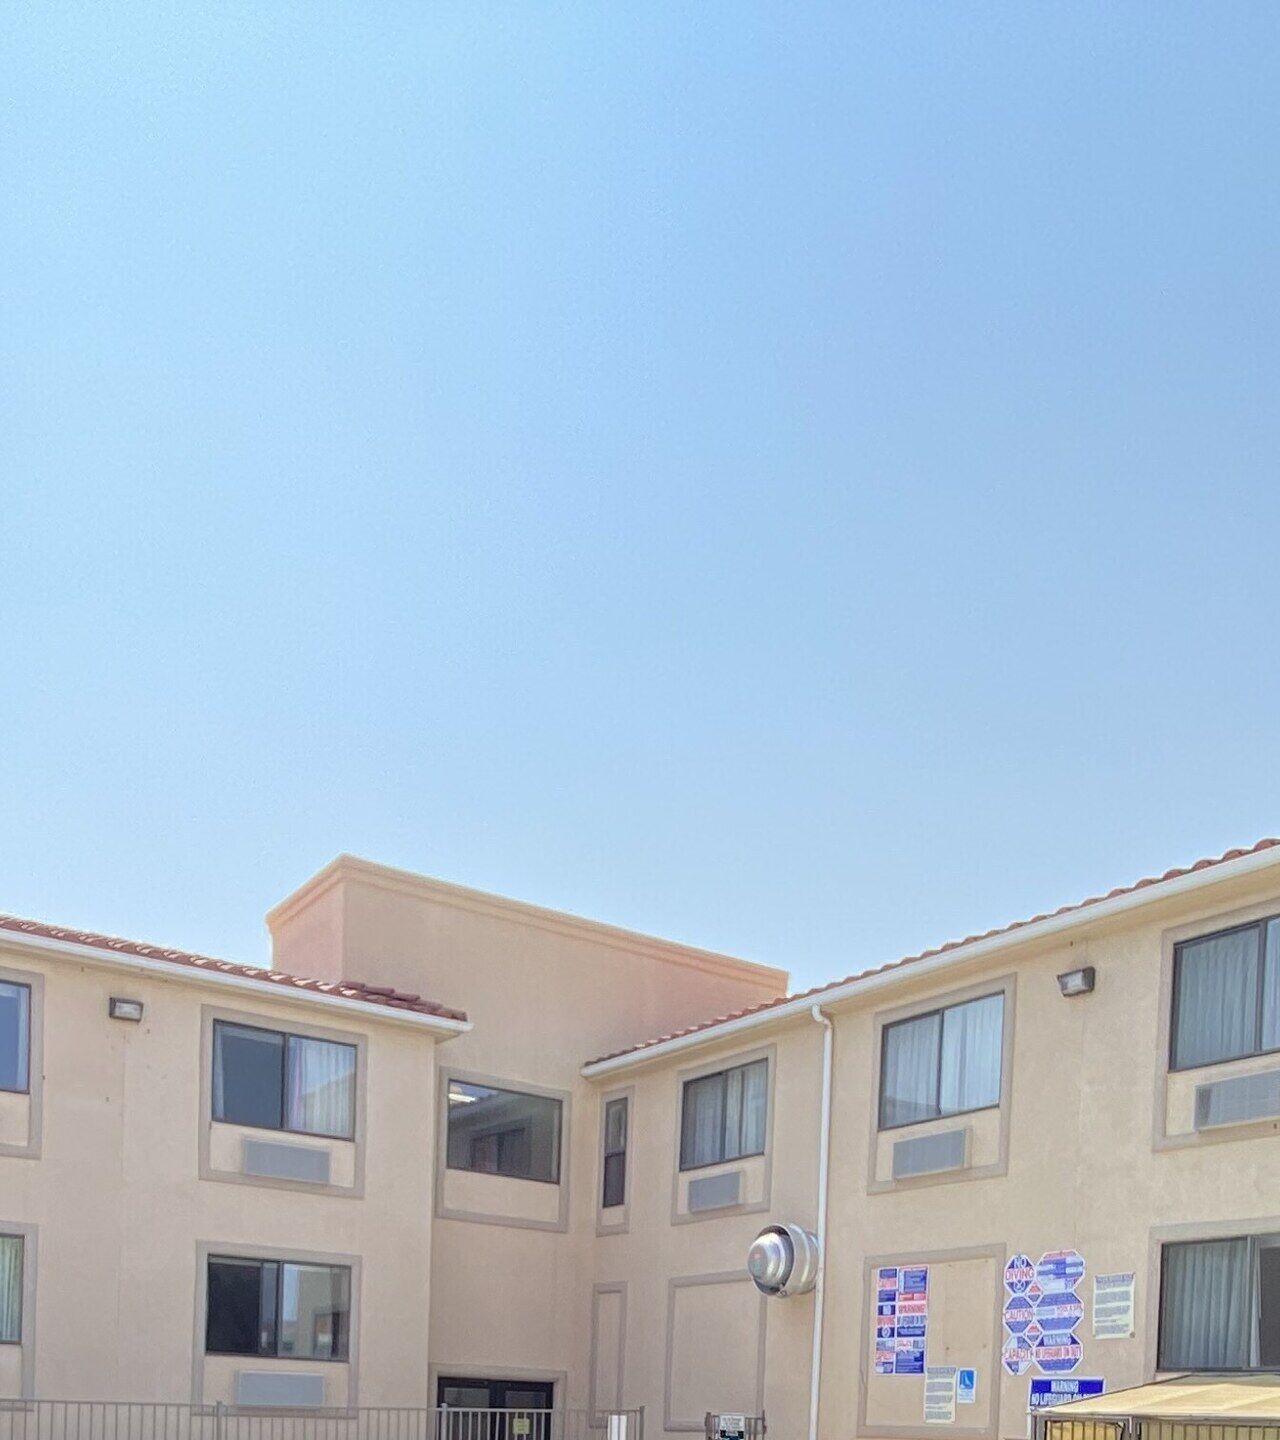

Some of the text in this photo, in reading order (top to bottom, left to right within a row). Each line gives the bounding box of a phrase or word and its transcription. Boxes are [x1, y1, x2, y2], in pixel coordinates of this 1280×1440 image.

[1014, 1257, 1027, 1268] NO
[1005, 1267, 1034, 1281] DIVING
[1005, 1309, 1033, 1322] CAUTION
[1051, 1380, 1079, 1393] WARNING
[1031, 1393, 1039, 1405] NO
